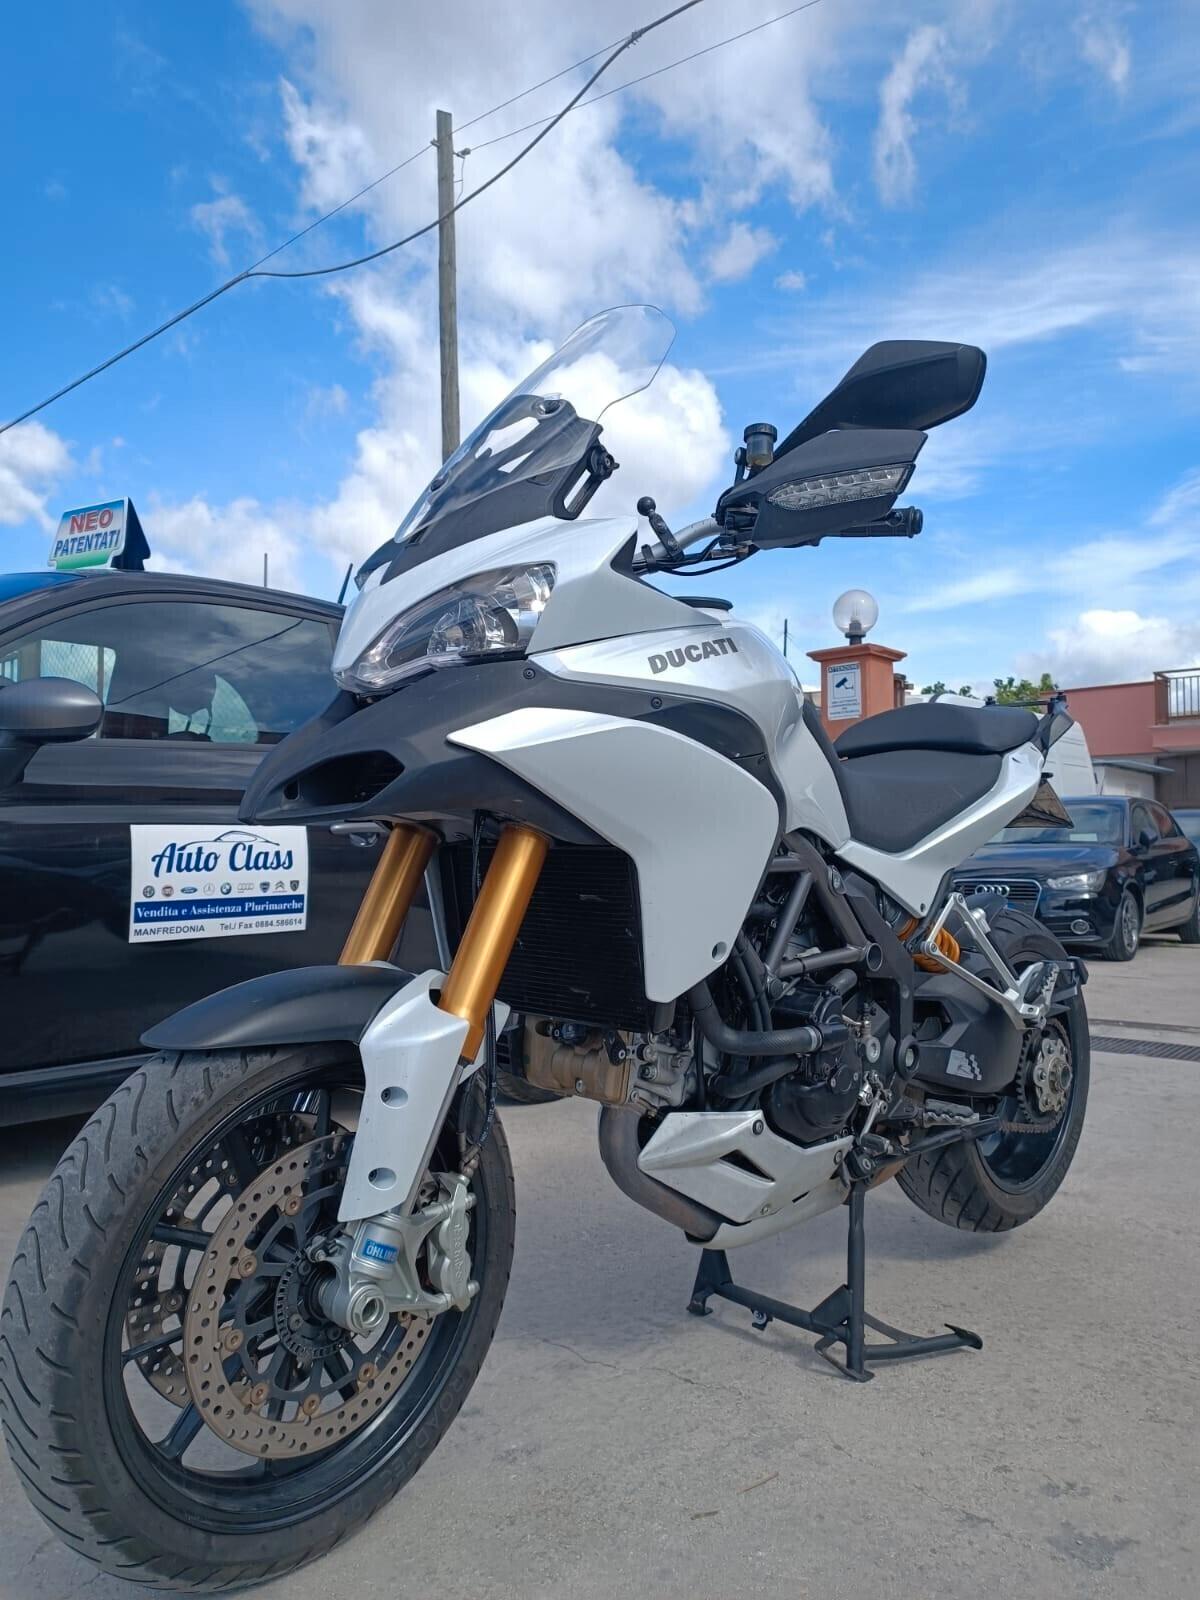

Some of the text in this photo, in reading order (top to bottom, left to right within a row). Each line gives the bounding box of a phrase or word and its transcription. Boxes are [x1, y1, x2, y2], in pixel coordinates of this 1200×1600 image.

[70, 509, 113, 534] NEO
[54, 530, 120, 558] PATENTATI
[648, 637, 739, 675] DUCATI
[151, 842, 293, 878] Auto Class
[137, 899, 303, 918] Vendita e Assistenza Plurimarche
[133, 924, 205, 937] MANFREDONIA
[238, 921, 253, 930] Fax
